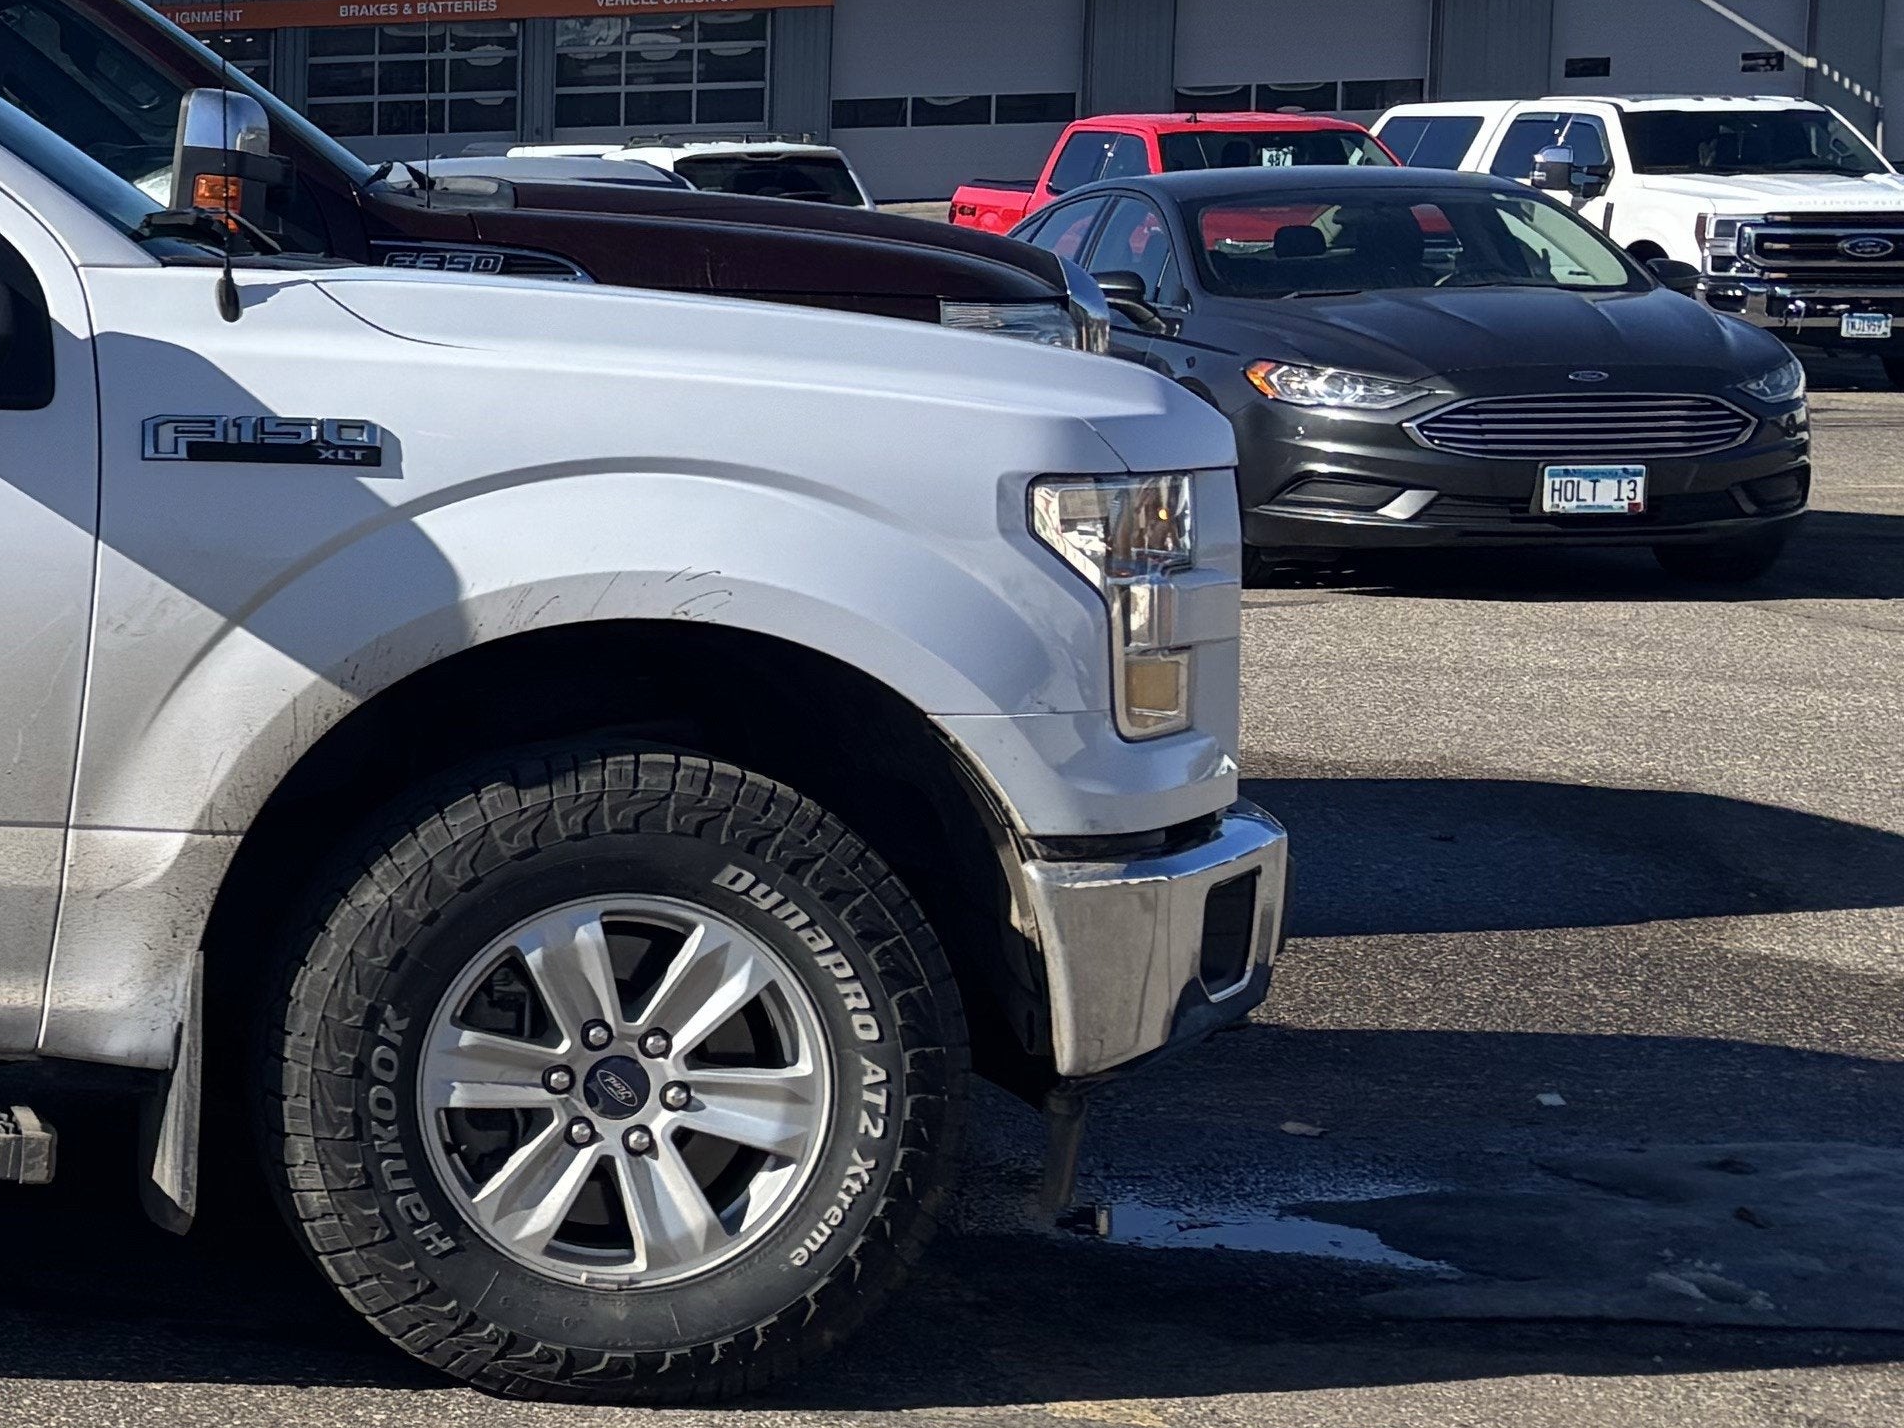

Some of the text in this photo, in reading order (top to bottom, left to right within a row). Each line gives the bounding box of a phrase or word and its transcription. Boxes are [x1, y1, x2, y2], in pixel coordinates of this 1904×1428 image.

[166, 9, 244, 24] IGNMENT
[339, 0, 498, 18] BRAKES & BATTERIES
[318, 448, 367, 461] XLT
[1550, 478, 1638, 502] HOLT 13
